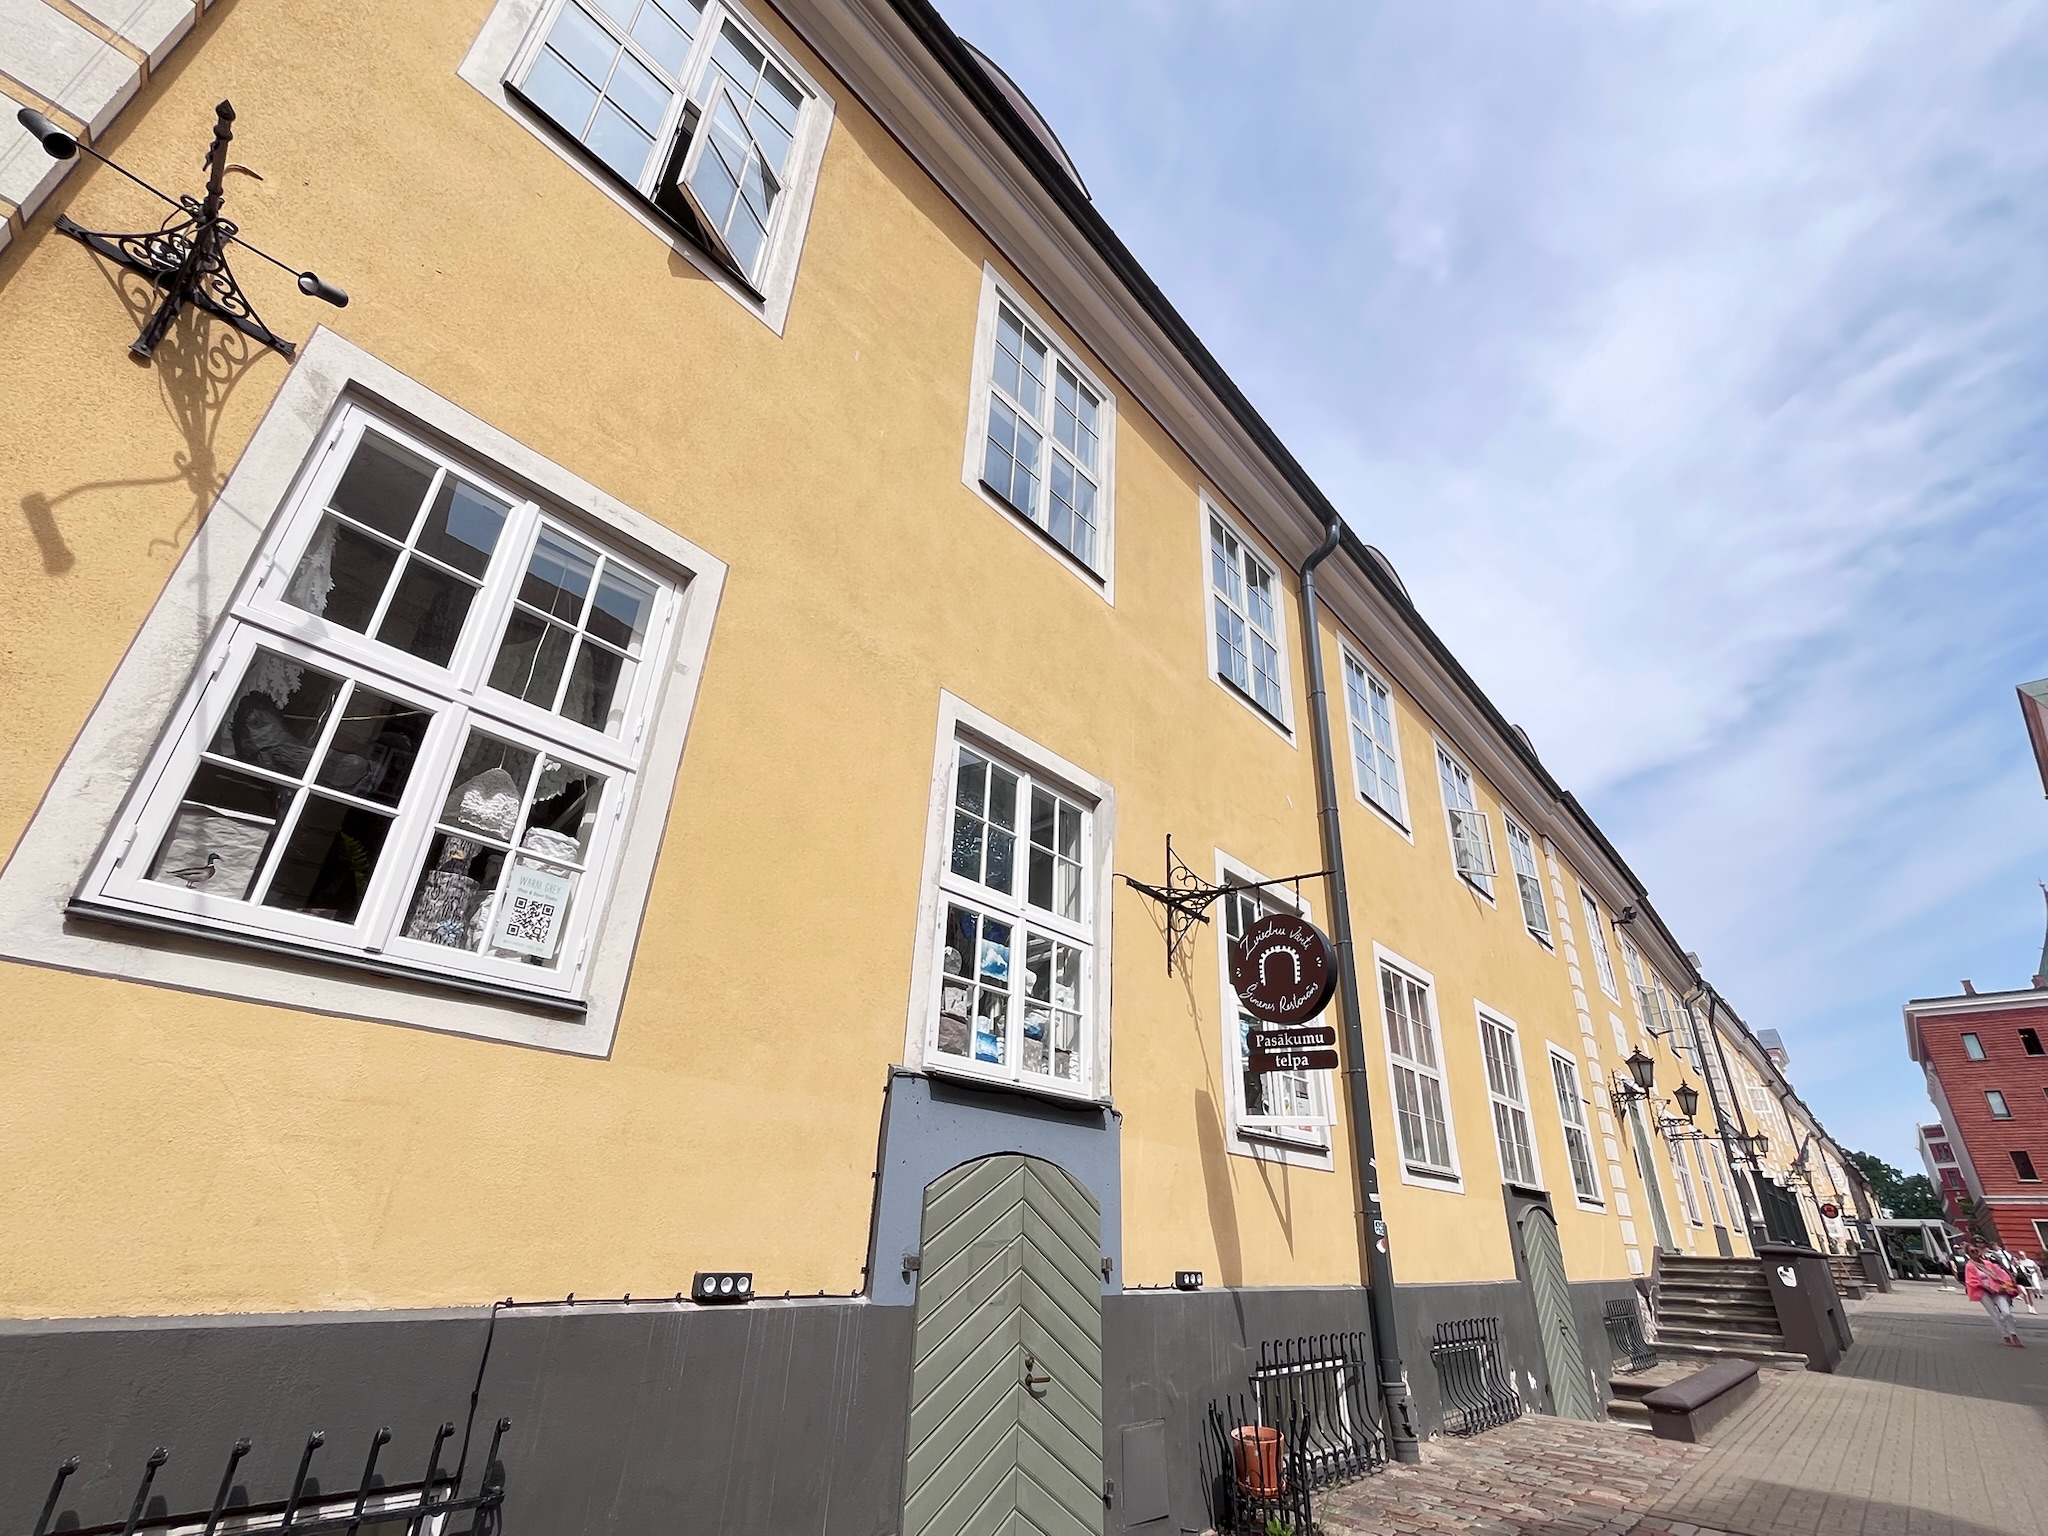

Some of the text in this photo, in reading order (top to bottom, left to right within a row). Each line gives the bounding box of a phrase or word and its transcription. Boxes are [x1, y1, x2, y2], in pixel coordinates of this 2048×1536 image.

[519, 876, 562, 895] WARM GREY
[1240, 921, 1286, 961] Zviedru
[1255, 1033, 1325, 1048] Pasākumu
[1275, 1053, 1310, 1070] telpa
